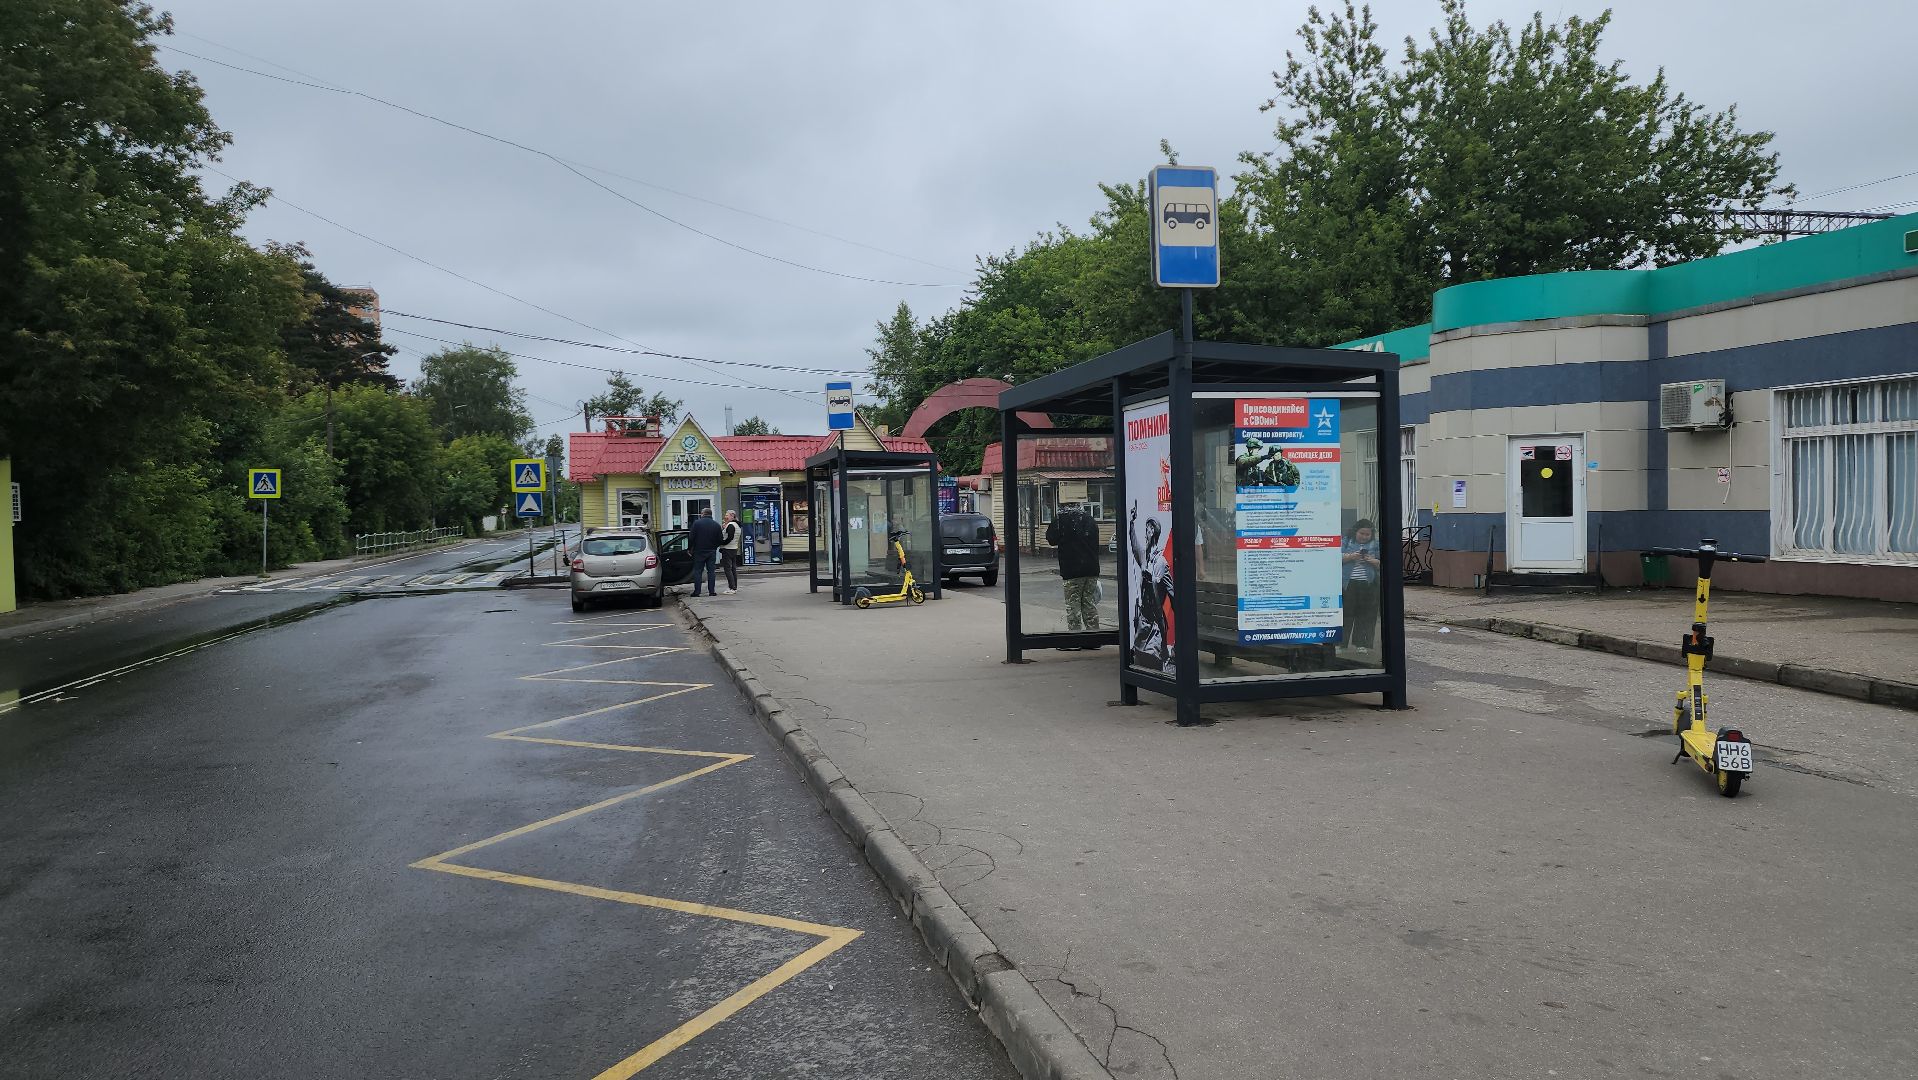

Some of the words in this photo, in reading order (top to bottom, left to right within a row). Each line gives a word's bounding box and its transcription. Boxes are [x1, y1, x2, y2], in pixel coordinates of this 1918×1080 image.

[1243, 404, 1304, 415] Присоединяйся
[1242, 430, 1262, 439] Служи
[675, 453, 706, 462] КАФЕ
[1319, 452, 1333, 460] ДЕЛО
[664, 462, 717, 471] ПЕКАРНЯ
